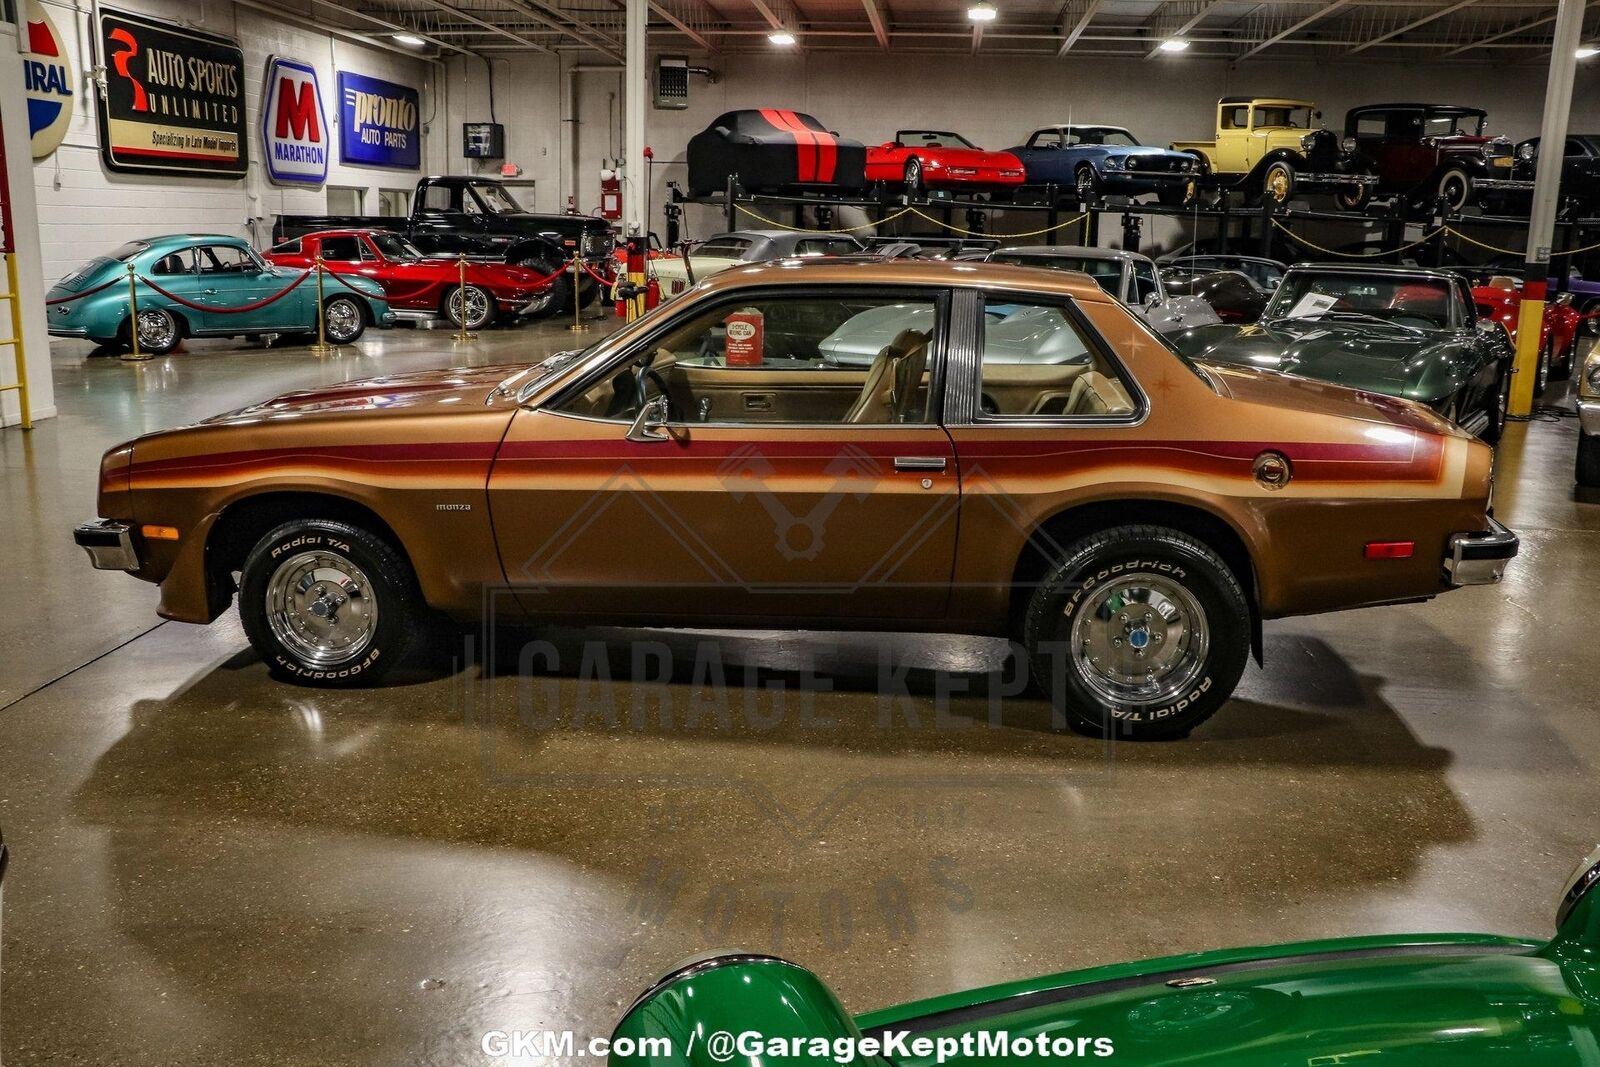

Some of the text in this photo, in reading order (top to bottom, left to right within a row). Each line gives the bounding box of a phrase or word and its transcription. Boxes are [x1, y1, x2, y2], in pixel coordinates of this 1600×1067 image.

[146, 48, 238, 98] AUTO SPORTS
[149, 93, 238, 124] UNLIMITED
[275, 77, 320, 143] M
[354, 91, 416, 133] pronto
[152, 130, 185, 149] Specializing
[191, 135, 202, 149] Late
[203, 136, 218, 150] Model
[218, 137, 236, 152] Imports
[274, 142, 323, 164] MARATHON
[361, 128, 407, 149] AUTO PARTS
[271, 536, 350, 559] Radial T/A
[1063, 559, 1187, 618] BFGoodrich
[276, 648, 381, 680] BFGoodrich
[1110, 676, 1213, 721] Radial T/A
